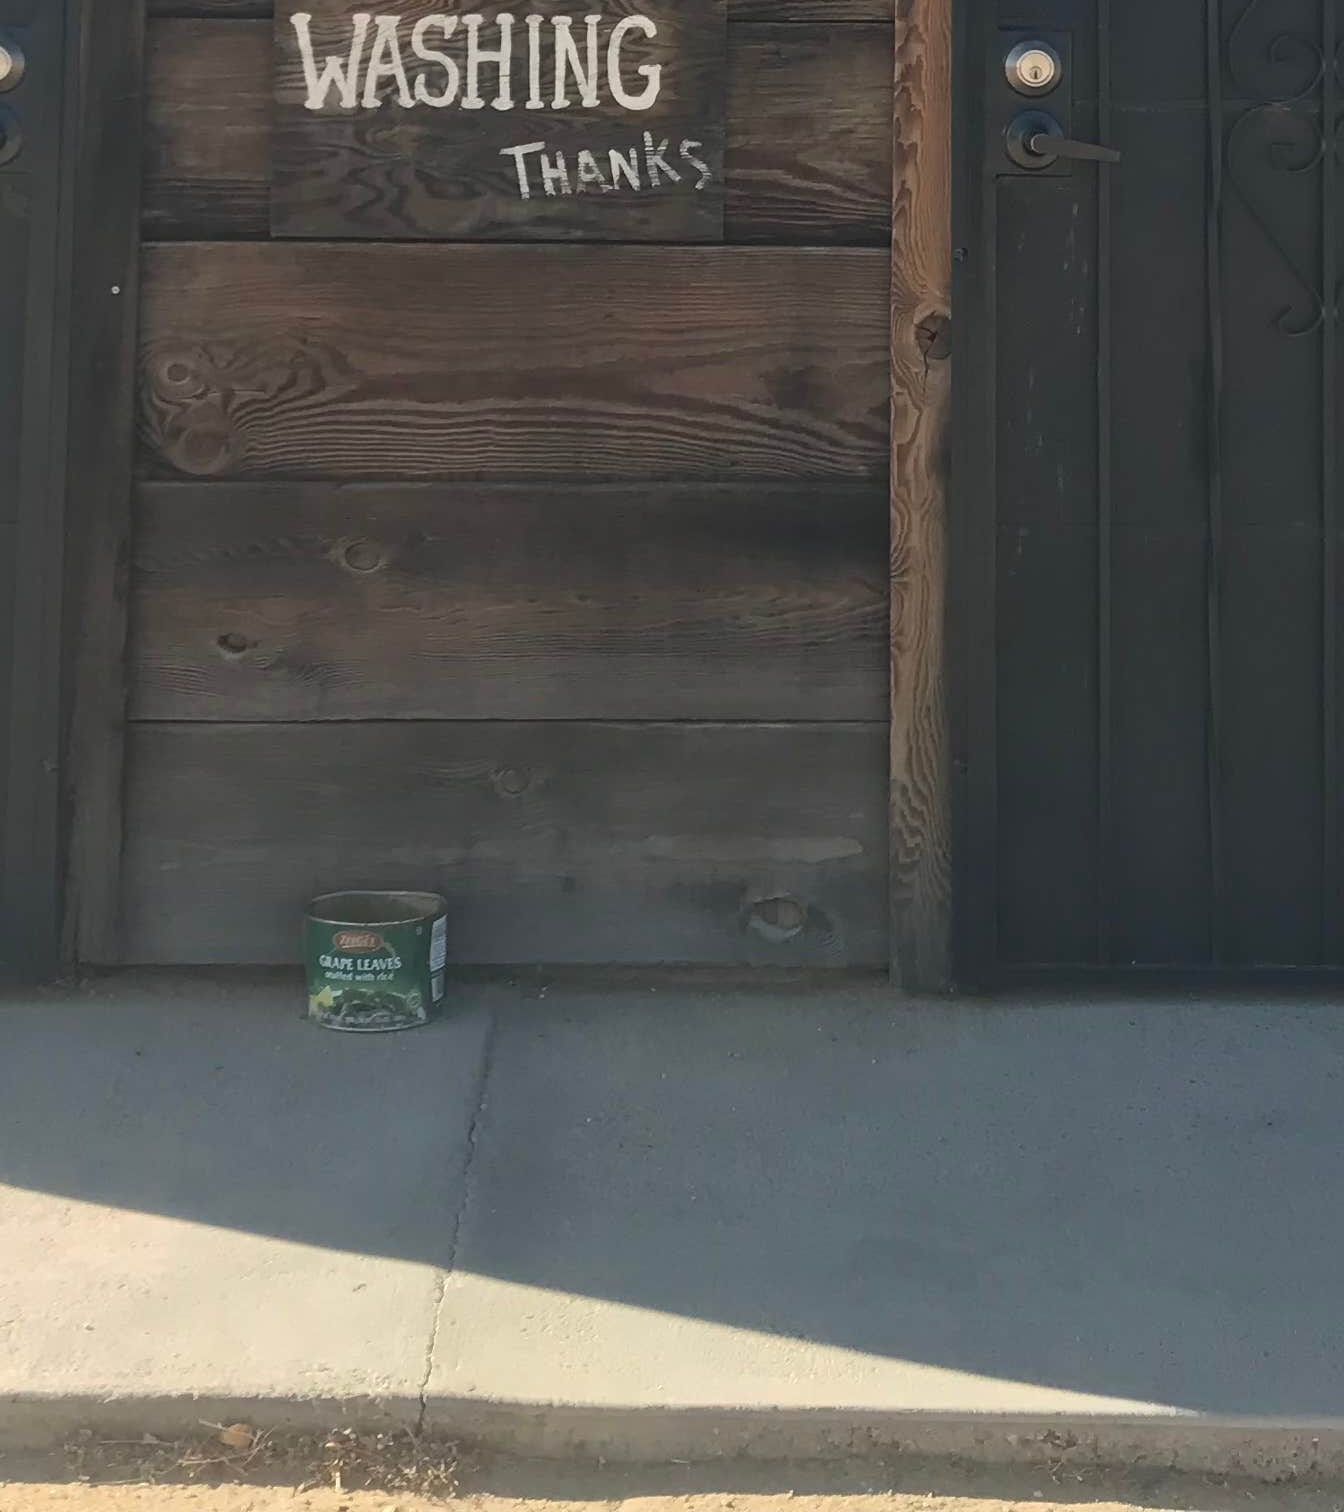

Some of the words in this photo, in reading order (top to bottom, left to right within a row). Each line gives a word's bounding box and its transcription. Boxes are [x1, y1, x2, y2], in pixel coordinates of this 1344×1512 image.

[290, 13, 662, 111] WASHING
[499, 131, 713, 200] THANKS
[319, 954, 354, 971] GRAPE
[357, 956, 402, 971] LEAVES
